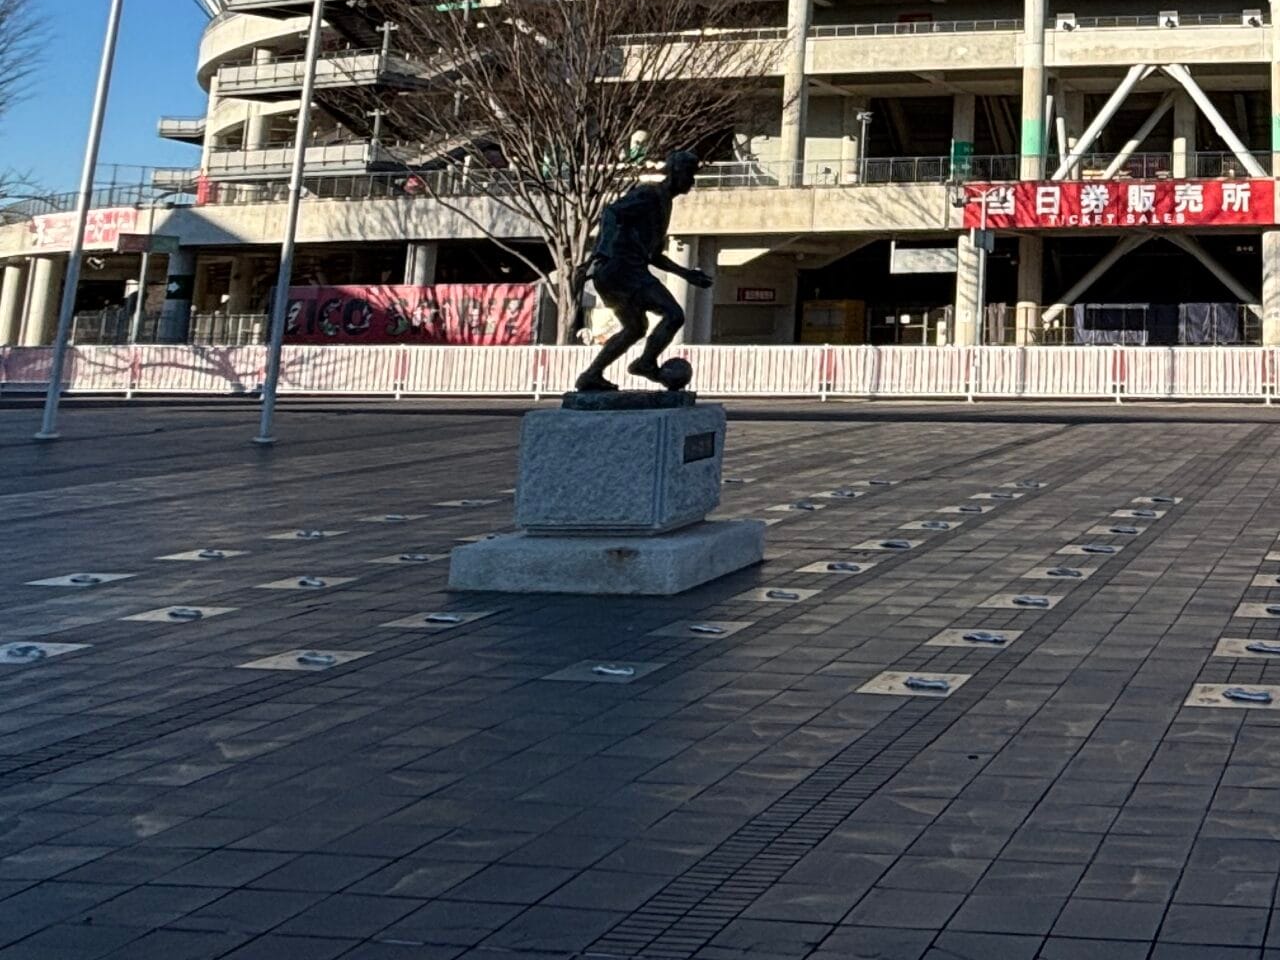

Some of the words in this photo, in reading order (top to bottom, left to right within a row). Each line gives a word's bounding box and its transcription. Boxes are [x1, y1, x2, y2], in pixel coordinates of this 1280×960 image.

[985, 183, 1251, 215] 当日券販売所
[1049, 214, 1114, 225] TICKET
[1126, 213, 1186, 224] SALES
